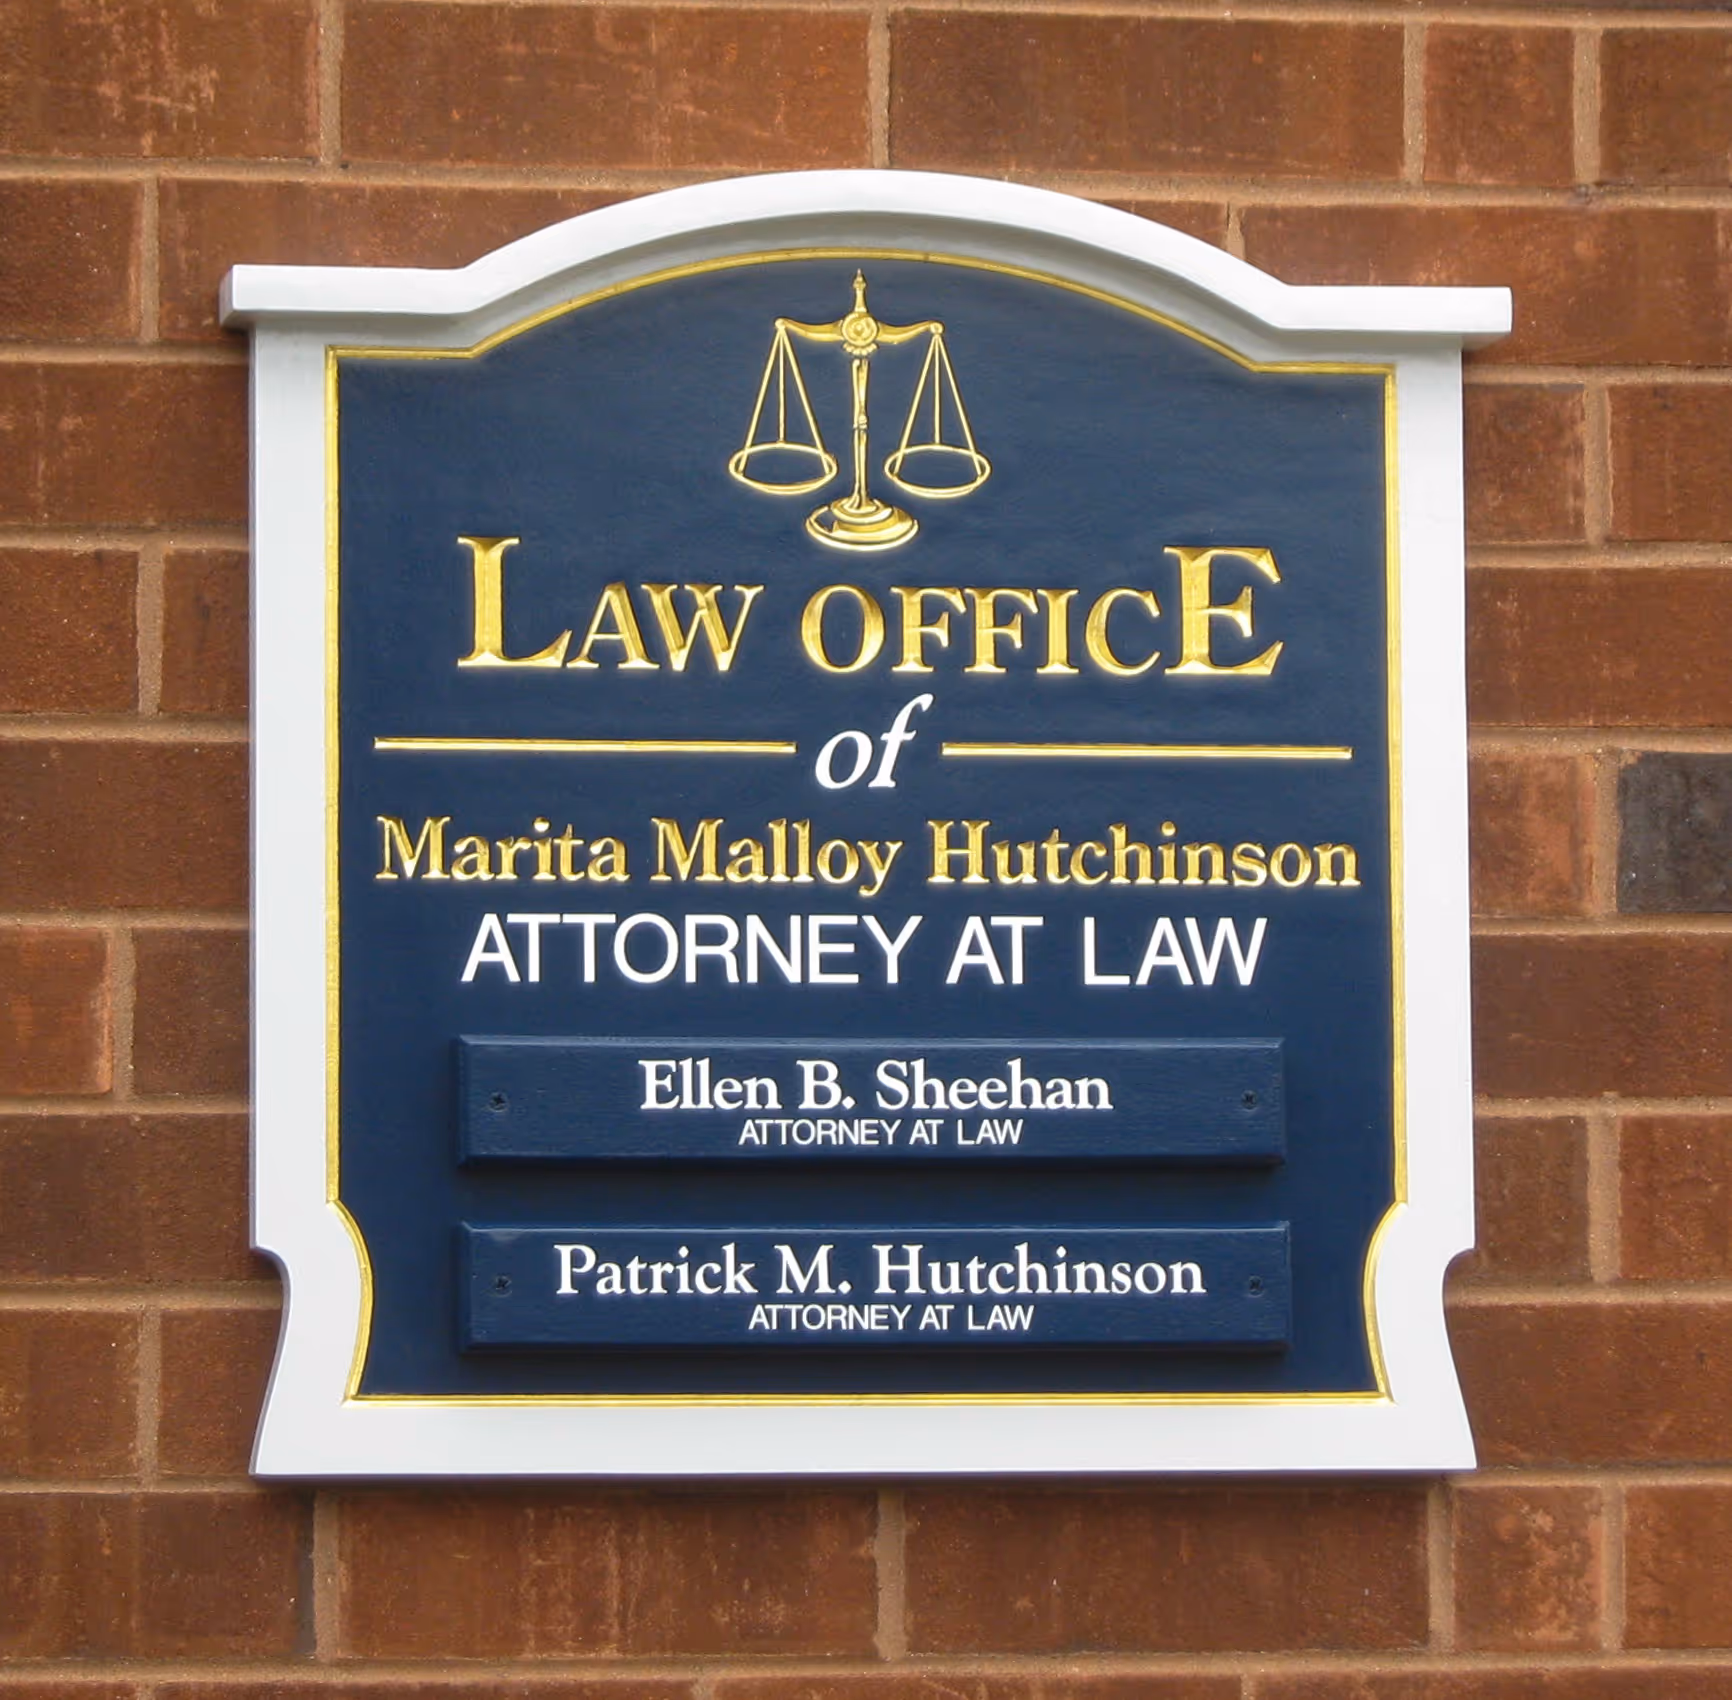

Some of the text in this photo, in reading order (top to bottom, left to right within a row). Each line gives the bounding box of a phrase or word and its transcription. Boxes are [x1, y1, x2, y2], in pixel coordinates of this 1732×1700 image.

[457, 536, 1284, 680] LAW OFFICE
[814, 692, 934, 791] of
[375, 815, 1362, 899] Marita Malloy Hutchinson
[460, 912, 1268, 987] ATTORNEY AT LAW
[637, 1057, 1114, 1112] Ellen B. Sheehan
[738, 1118, 1024, 1147] ATTORNEY AT LAW
[553, 1241, 1207, 1296] Patrick M. Hutchinson
[747, 1303, 1035, 1332] ATTORNEY AT LAW
